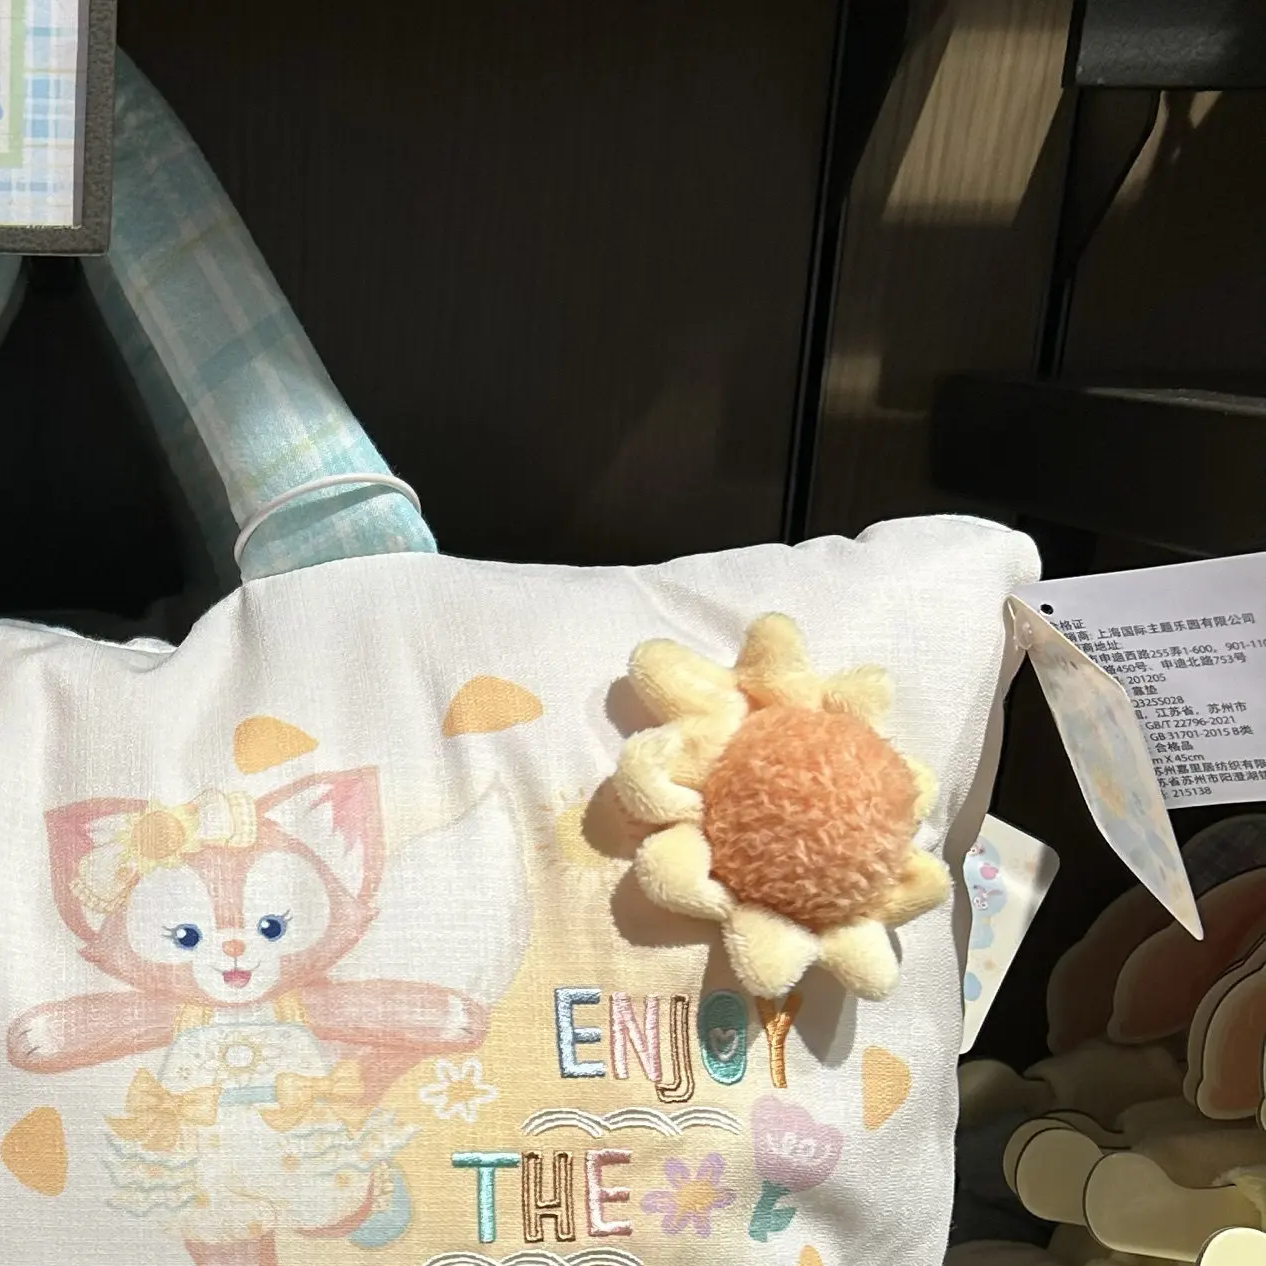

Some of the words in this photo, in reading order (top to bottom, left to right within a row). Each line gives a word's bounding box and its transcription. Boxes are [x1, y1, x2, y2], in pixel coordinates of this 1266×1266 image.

[1173, 786, 1212, 798] 215138
[553, 986, 801, 1103] ENJOY
[452, 1148, 634, 1244] THE
